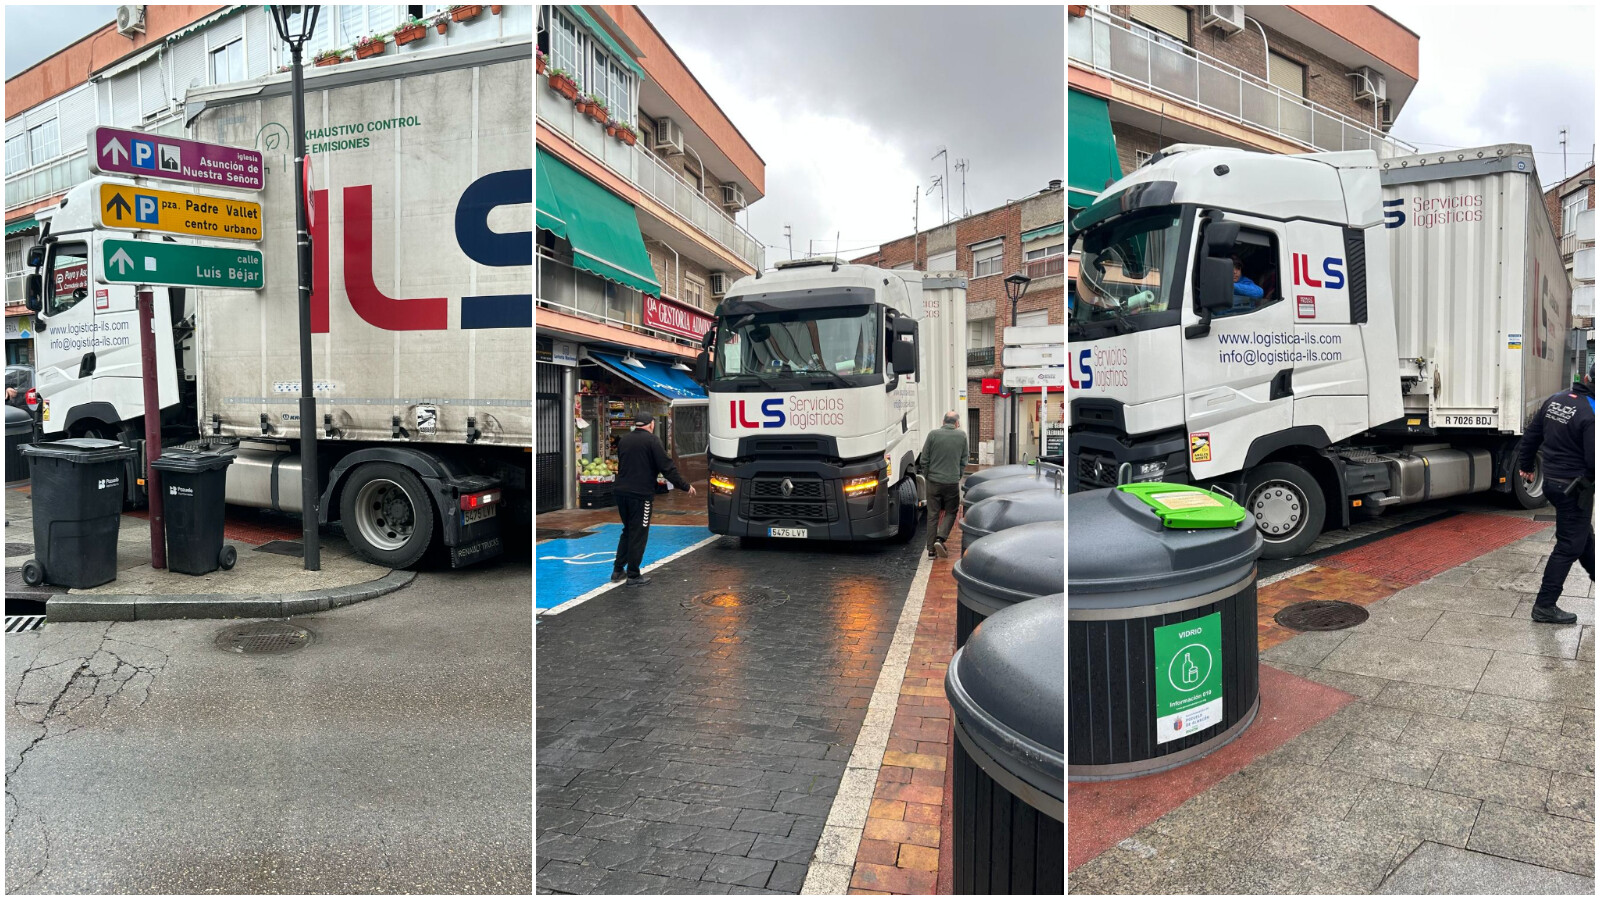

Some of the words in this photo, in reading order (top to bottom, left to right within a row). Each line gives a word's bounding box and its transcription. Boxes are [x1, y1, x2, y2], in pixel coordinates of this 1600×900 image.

[304, 123, 364, 140] XHAUSTIVO
[367, 115, 421, 132] CONTROL
[304, 145, 310, 154] E
[312, 137, 370, 154] EMISIONES
[200, 156, 244, 171] Asunción
[247, 164, 259, 173] de
[237, 152, 258, 162] iglesia
[183, 166, 222, 180] Nuestra
[226, 172, 259, 185] Señora
[161, 200, 181, 210] pza.
[186, 199, 218, 214] Padre
[226, 204, 258, 219] Vallet
[1413, 193, 1483, 212] Servicios
[1413, 209, 1483, 228] logísticos
[185, 220, 218, 231] centro
[224, 224, 257, 235] urbano
[237, 255, 259, 264] calle
[228, 267, 259, 282] Béjar
[1292, 253, 1345, 289] ILS
[50, 321, 129, 335] www.logistica-ils.com
[50, 336, 129, 350] info@logistica-ils.com
[1218, 331, 1341, 348] www.logistica-ils.com
[1094, 345, 1128, 367] Servicios
[1219, 349, 1342, 365] info@logistica-ils.com
[1094, 367, 1129, 392] logísticos
[789, 395, 844, 411] Servicios
[1547, 401, 1577, 417] POLICÍA
[730, 398, 786, 428] ILS
[789, 411, 844, 430] logísticos
[1445, 417, 1451, 425] R
[1454, 417, 1473, 425] 7026
[1476, 417, 1492, 425] BDJ
[772, 528, 790, 537] 5475
[792, 529, 805, 537] LVY
[1178, 627, 1203, 639] VIDRIO
[1169, 694, 1203, 708] Información
